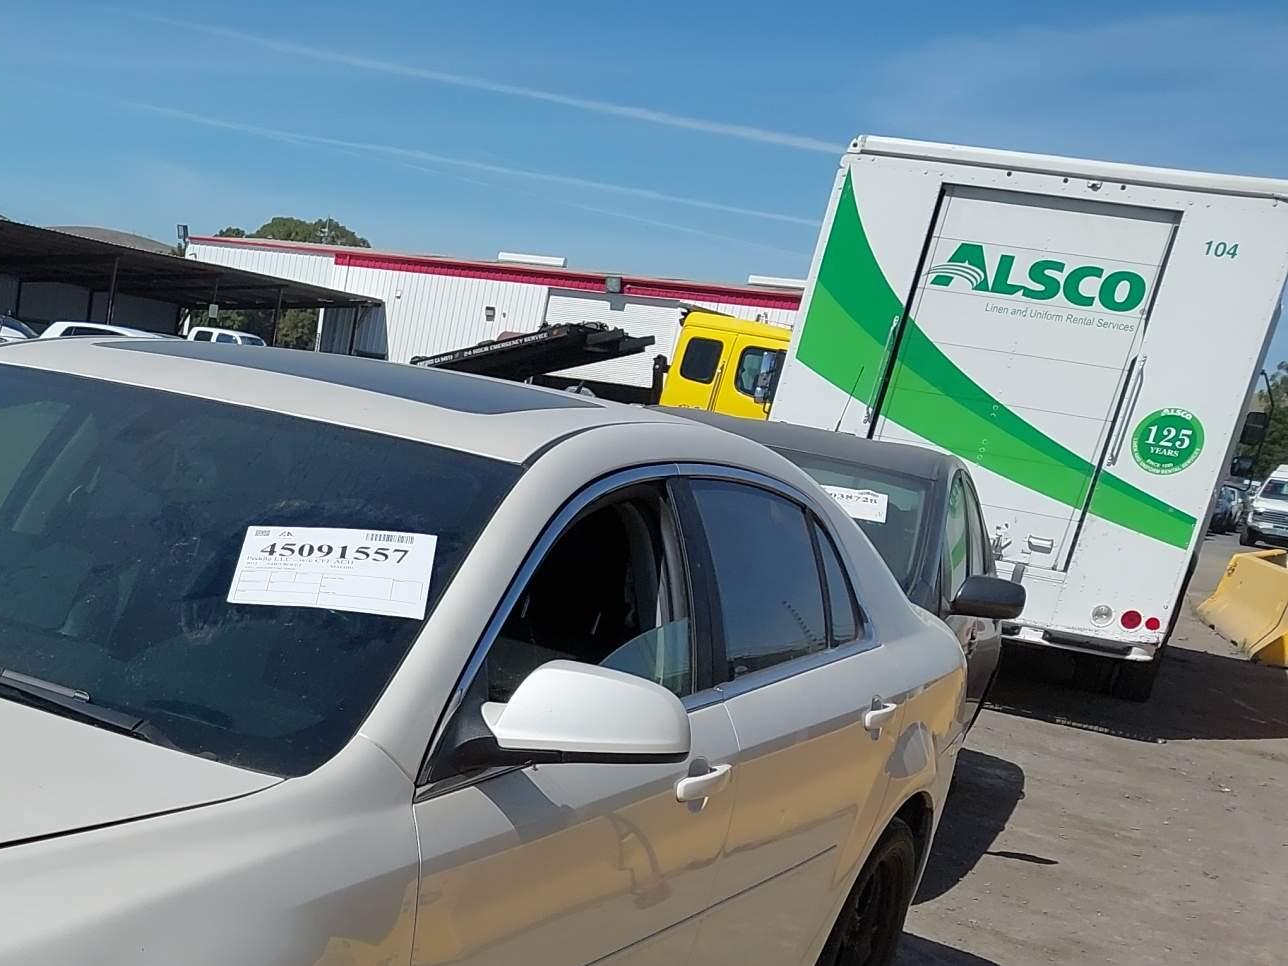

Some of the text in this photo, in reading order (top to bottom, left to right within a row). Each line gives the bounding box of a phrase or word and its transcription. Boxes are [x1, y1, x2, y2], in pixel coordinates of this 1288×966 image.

[1205, 240, 1239, 259] 104
[927, 242, 1146, 313] ALSCO
[985, 302, 1135, 333] Linen and Uniform Rental Services
[490, 338, 523, 351] EMERGENCY
[523, 331, 549, 343] SERVICE
[1160, 408, 1193, 421] ALSCO
[1144, 425, 1193, 449] 125
[1150, 446, 1179, 457] YEARS
[259, 542, 409, 564] 45091557
